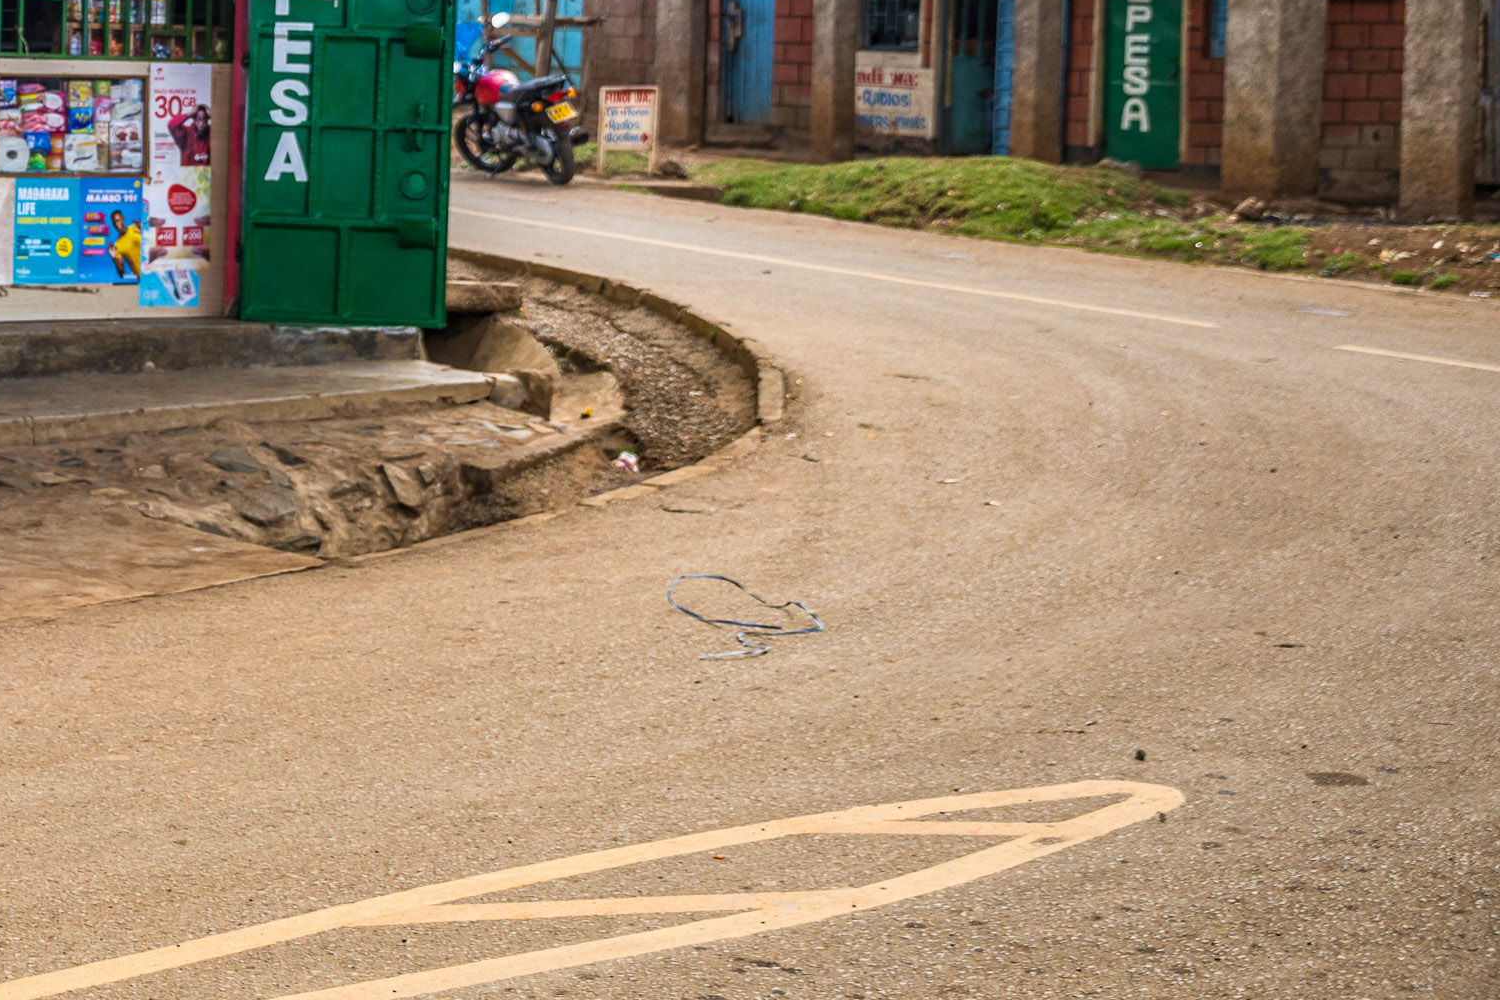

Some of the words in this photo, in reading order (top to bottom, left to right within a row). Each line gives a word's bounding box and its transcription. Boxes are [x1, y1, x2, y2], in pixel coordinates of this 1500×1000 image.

[154, 96, 182, 118] 30
[17, 187, 69, 201] MADARAKA
[17, 202, 36, 215] LIFE
